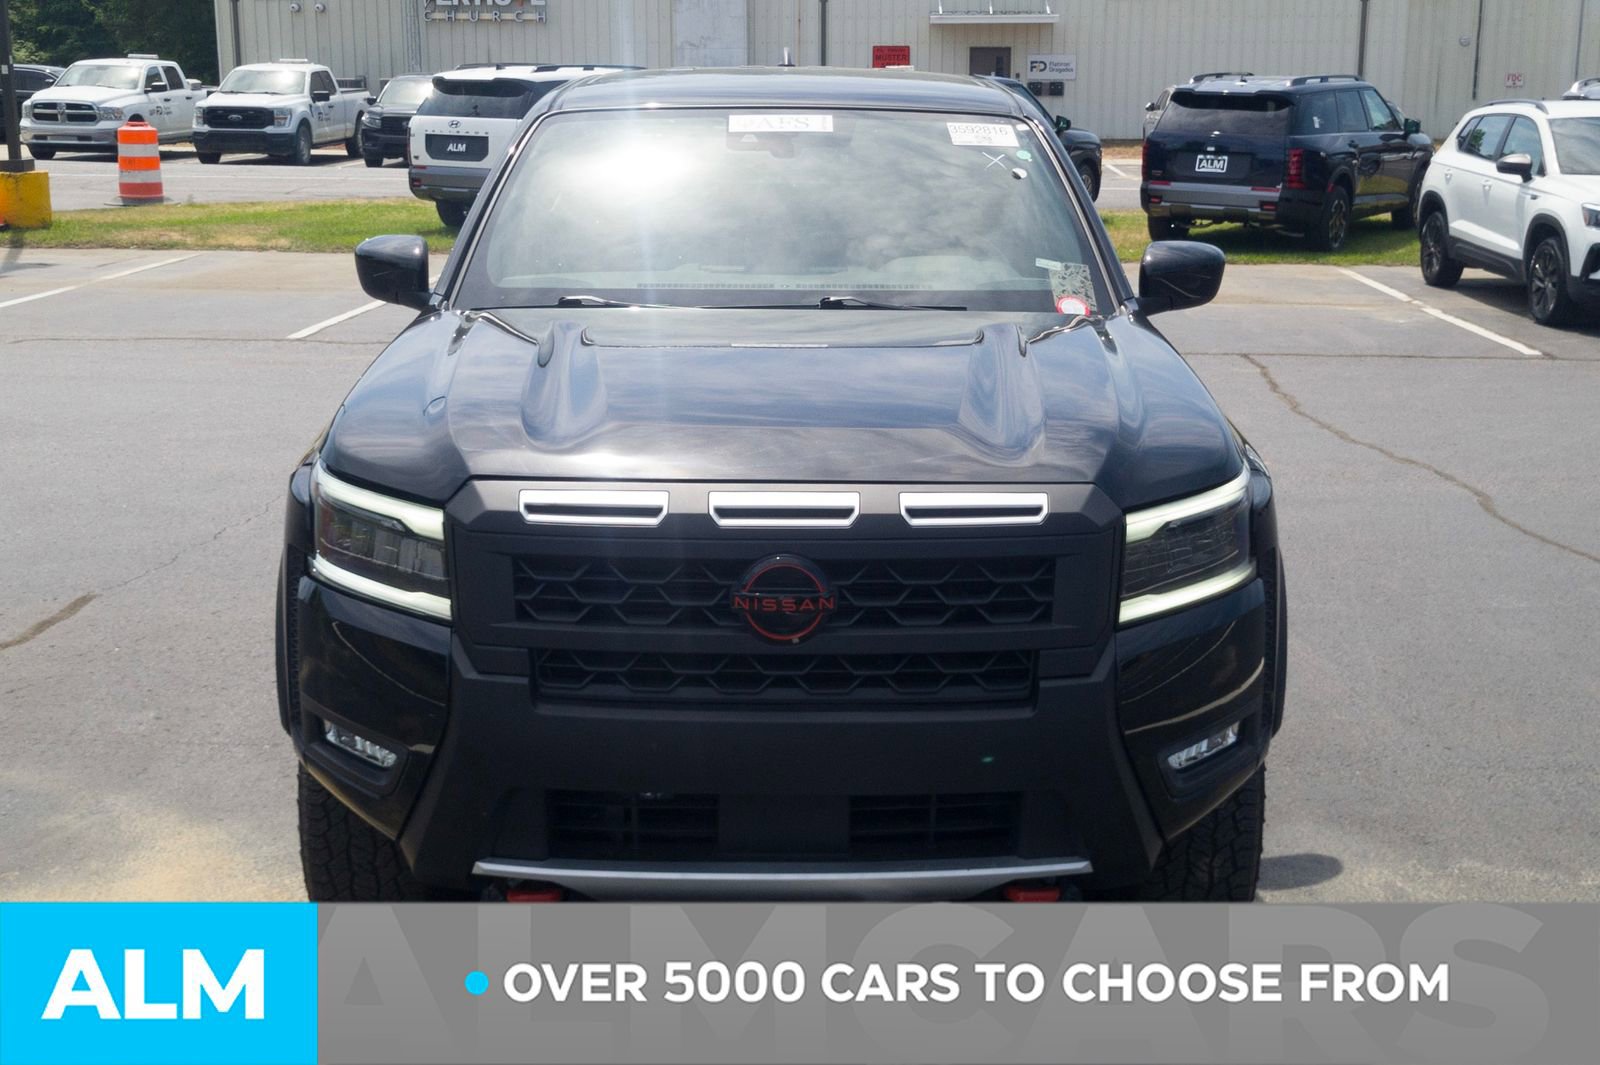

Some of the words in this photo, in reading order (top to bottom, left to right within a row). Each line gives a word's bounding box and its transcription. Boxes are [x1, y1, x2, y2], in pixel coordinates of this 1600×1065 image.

[424, 10, 547, 23] CHURCH
[447, 143, 467, 152] ALM
[1199, 160, 1224, 169] ALM
[734, 595, 835, 611] NISSAN
